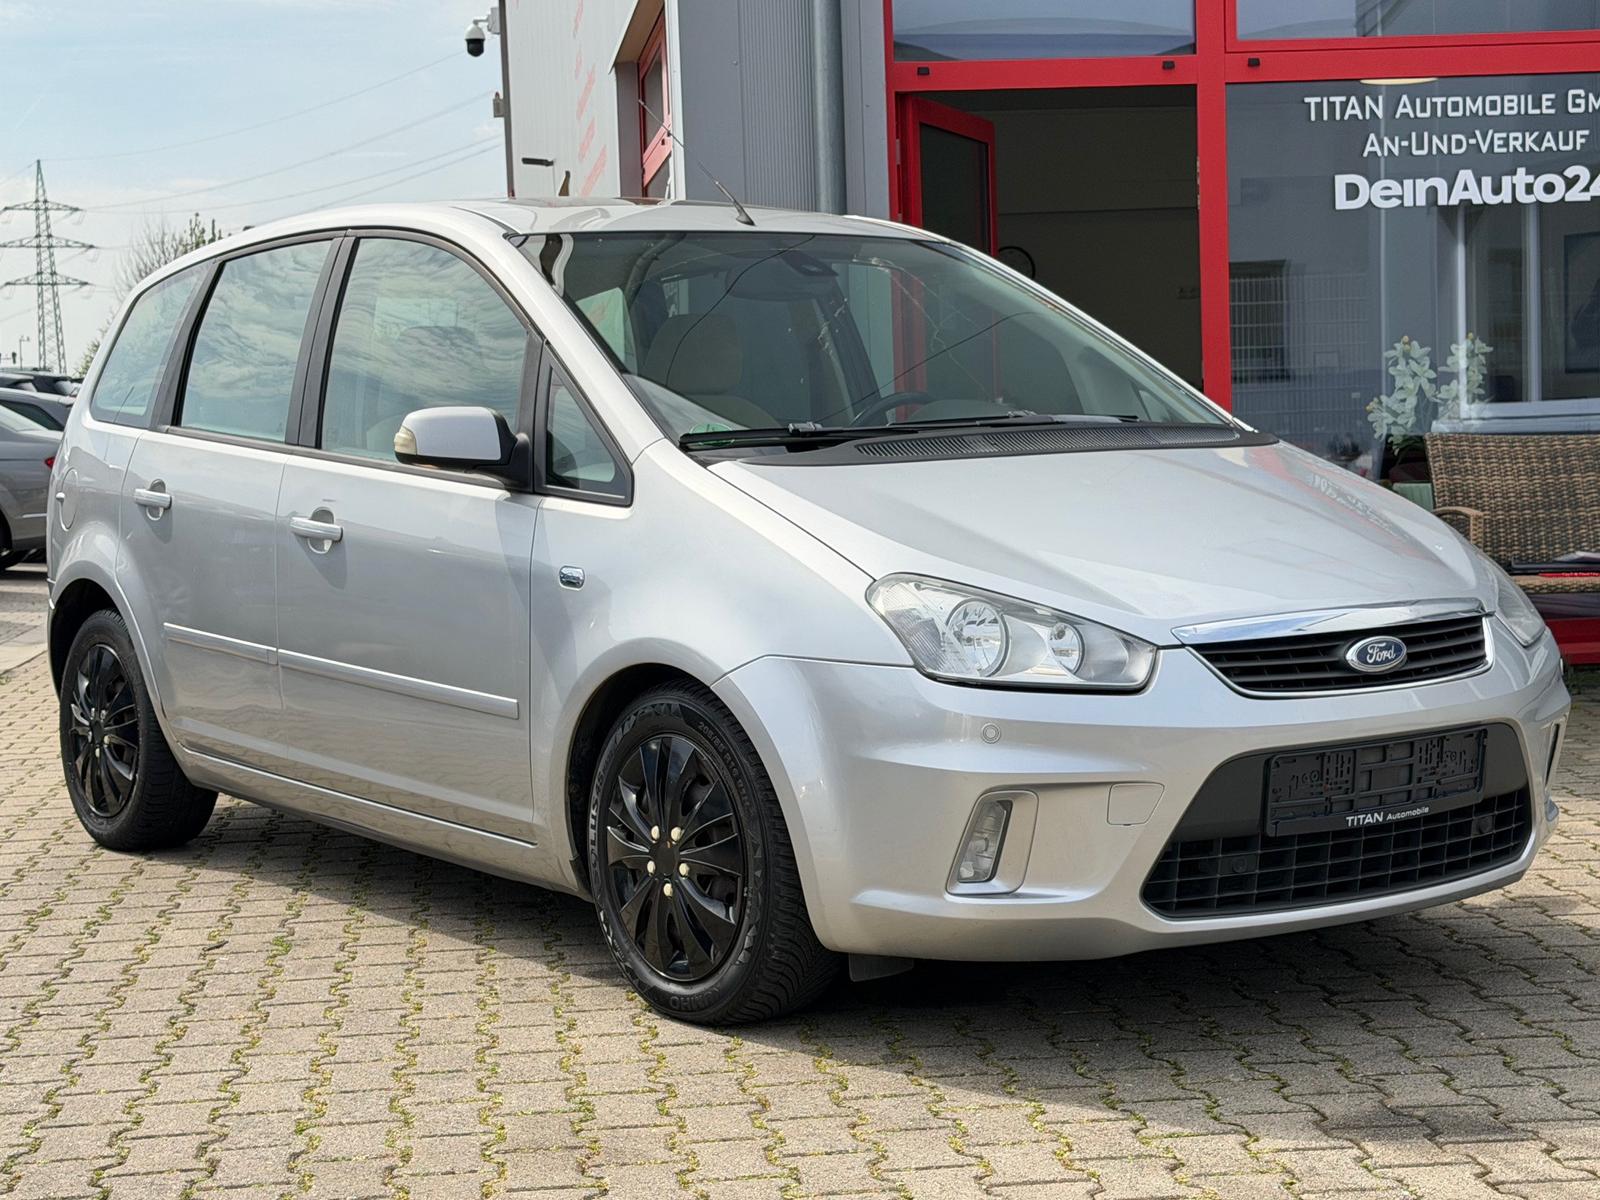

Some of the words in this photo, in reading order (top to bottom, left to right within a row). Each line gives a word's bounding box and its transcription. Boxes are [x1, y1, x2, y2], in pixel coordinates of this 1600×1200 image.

[1303, 95, 1383, 122] TITAN
[1395, 93, 1556, 119] AUTOMOBILE
[1366, 642, 1396, 664] Ford
[1346, 811, 1384, 827] TITAN
[1386, 806, 1430, 821] Automobile
